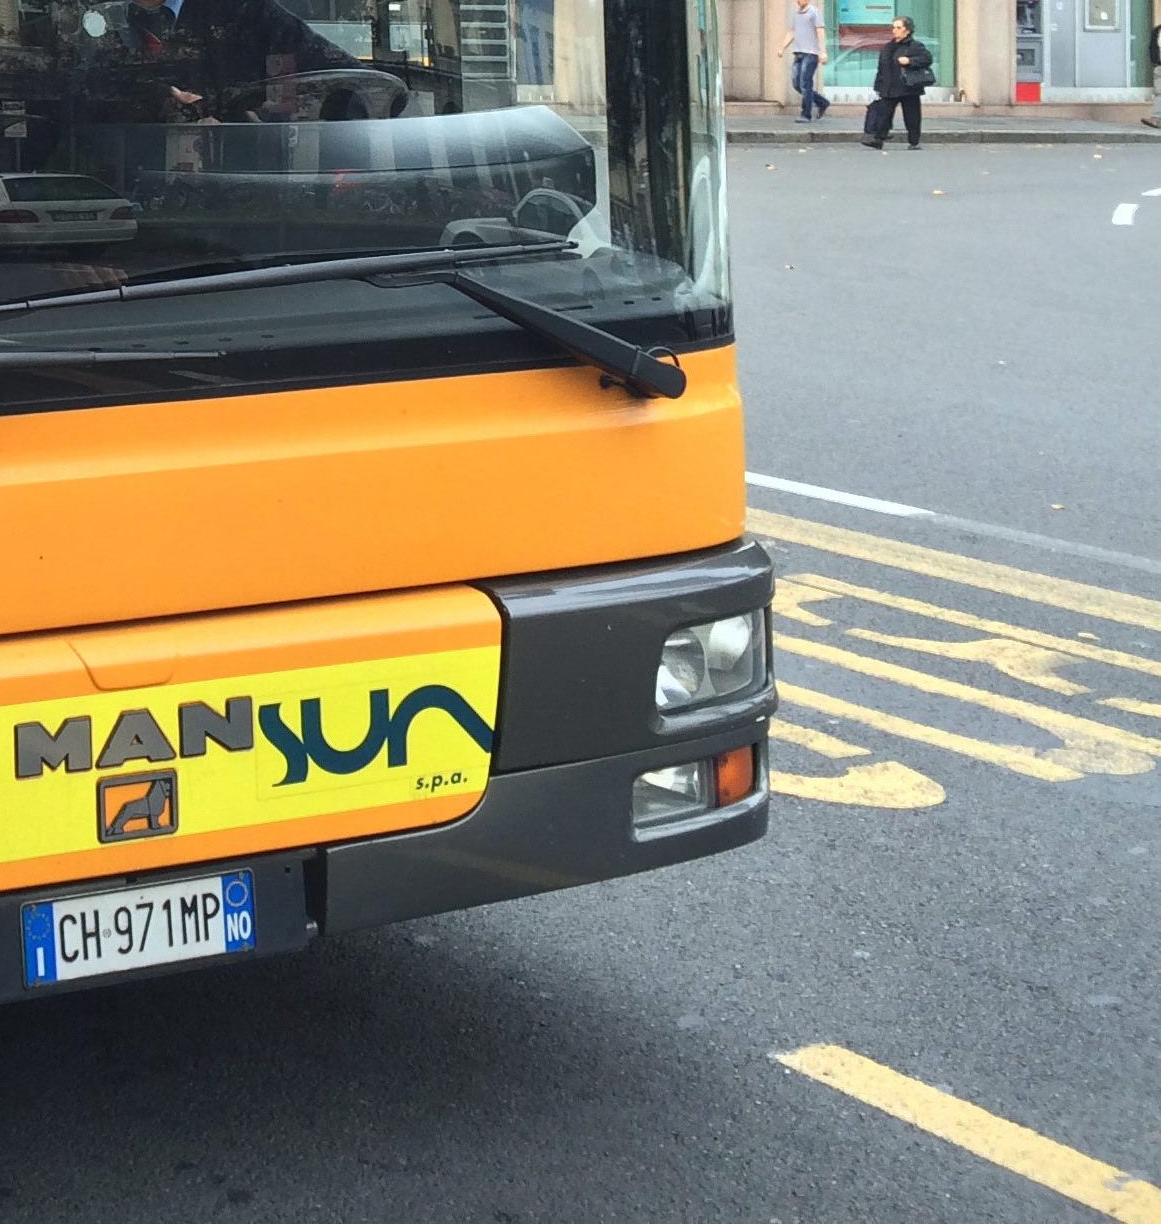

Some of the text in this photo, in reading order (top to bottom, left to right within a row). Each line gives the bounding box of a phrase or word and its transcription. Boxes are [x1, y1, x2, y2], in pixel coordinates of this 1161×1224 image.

[14, 696, 255, 780] MAN
[416, 769, 469, 791] s.p.a.
[59, 892, 221, 963] CH 971MP
[226, 910, 252, 943] NO
